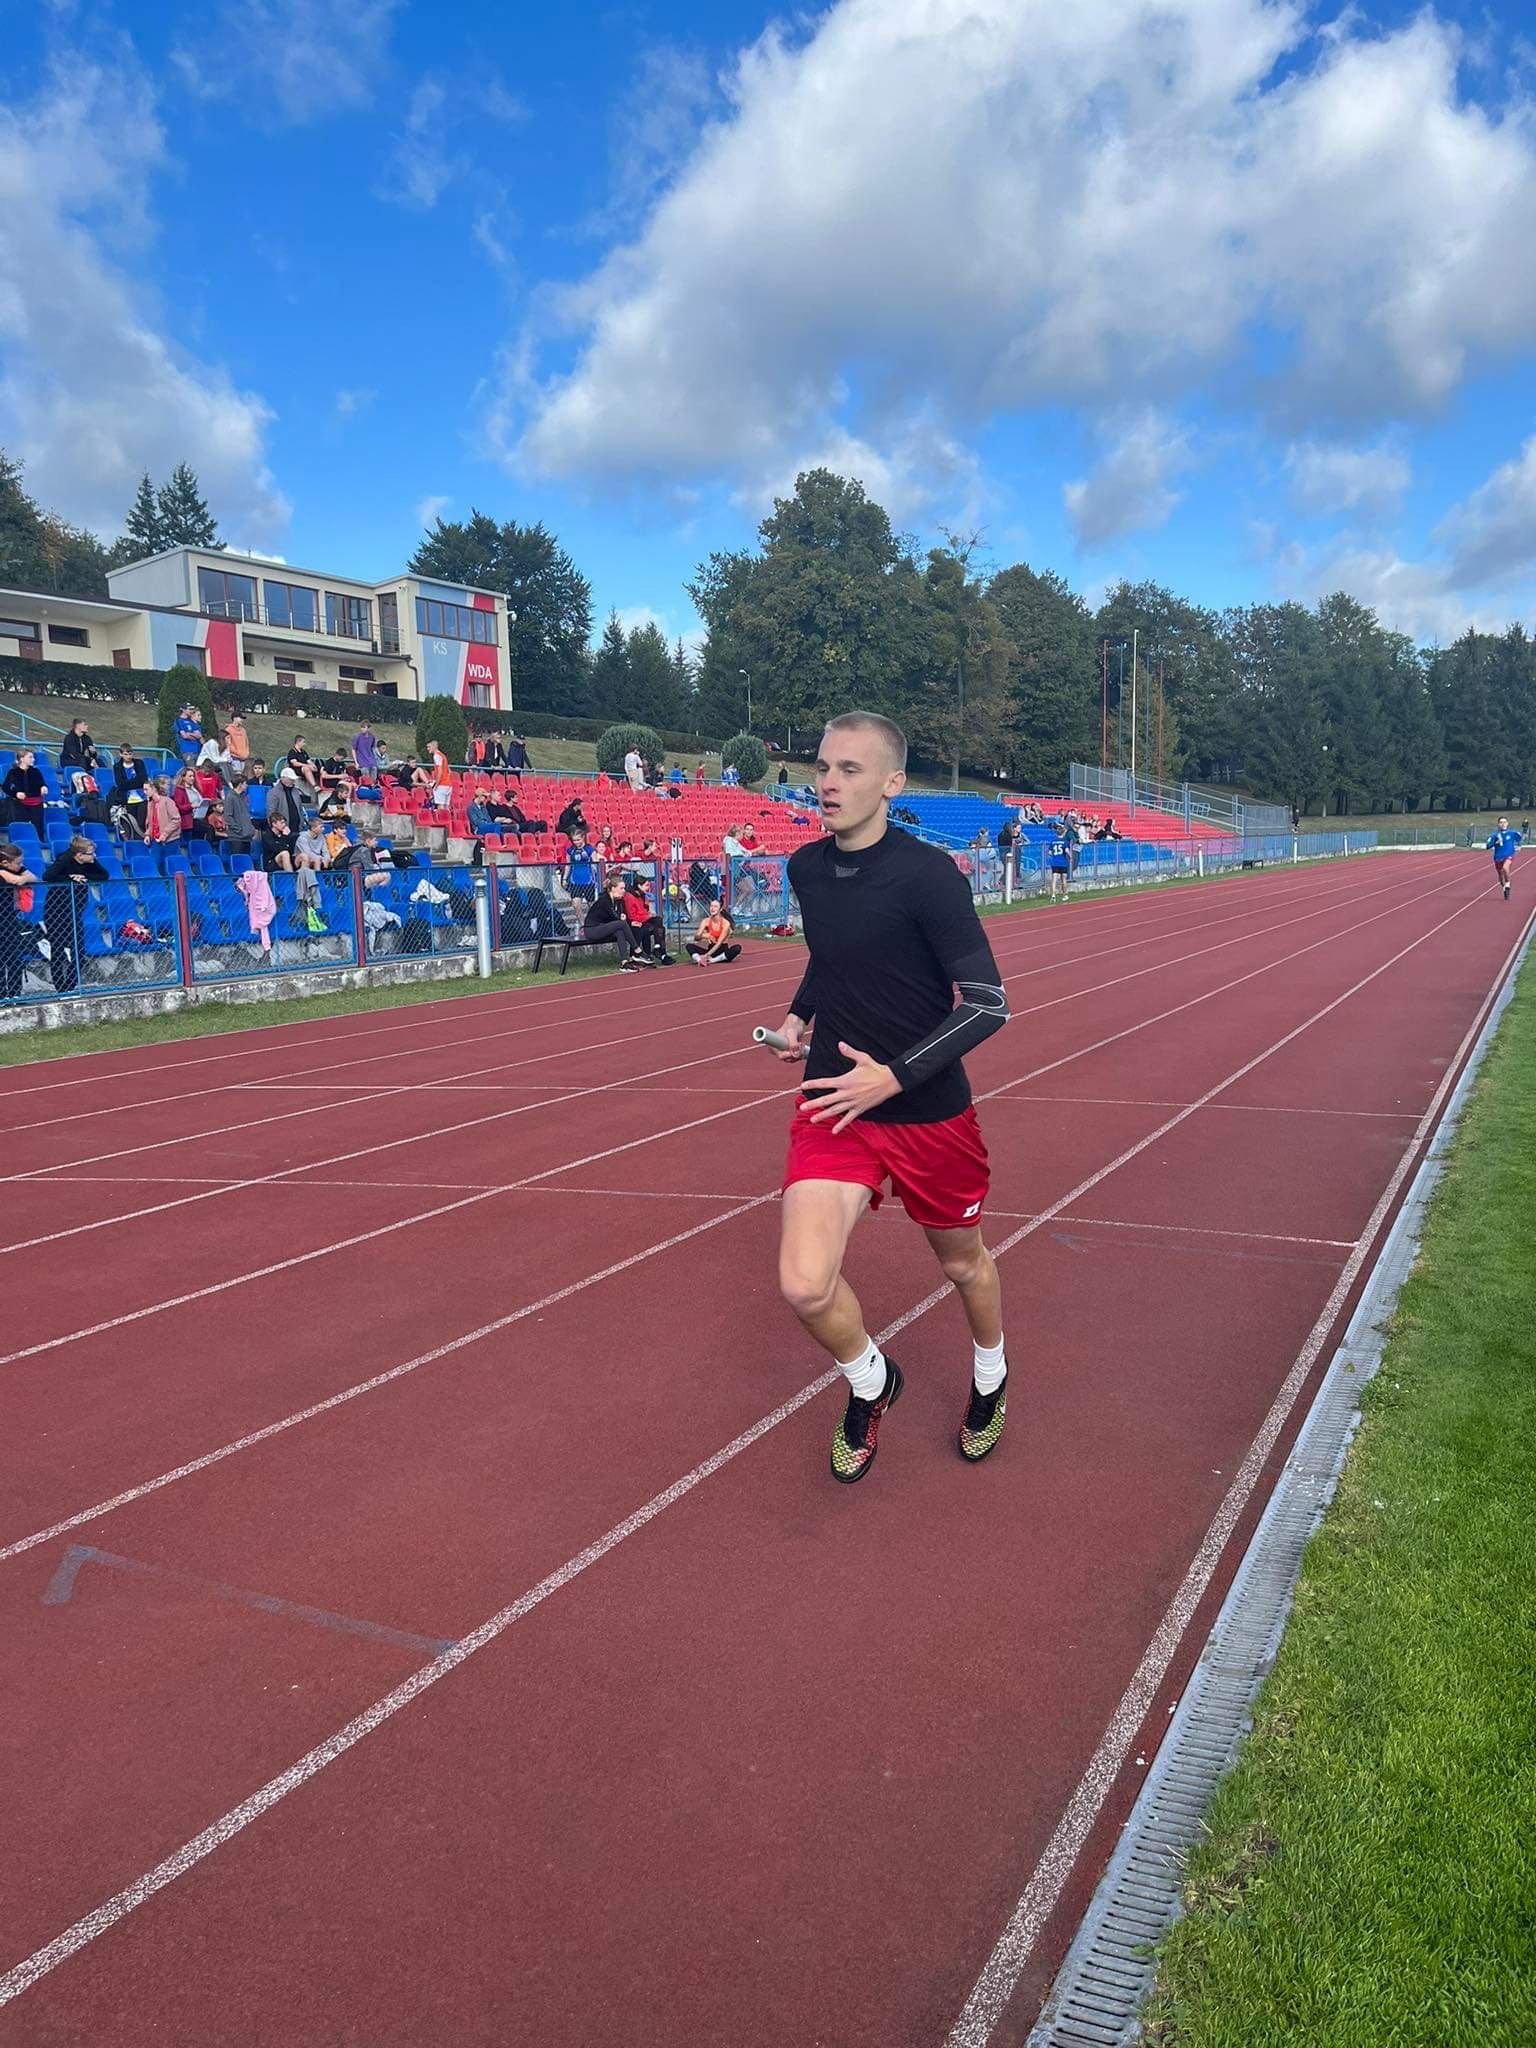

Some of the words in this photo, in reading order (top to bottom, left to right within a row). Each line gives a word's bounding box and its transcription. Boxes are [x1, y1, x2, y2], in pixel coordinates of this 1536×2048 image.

[433, 641, 448, 655] KS
[467, 664, 493, 680] WDA
[1053, 844, 1063, 856] 15
